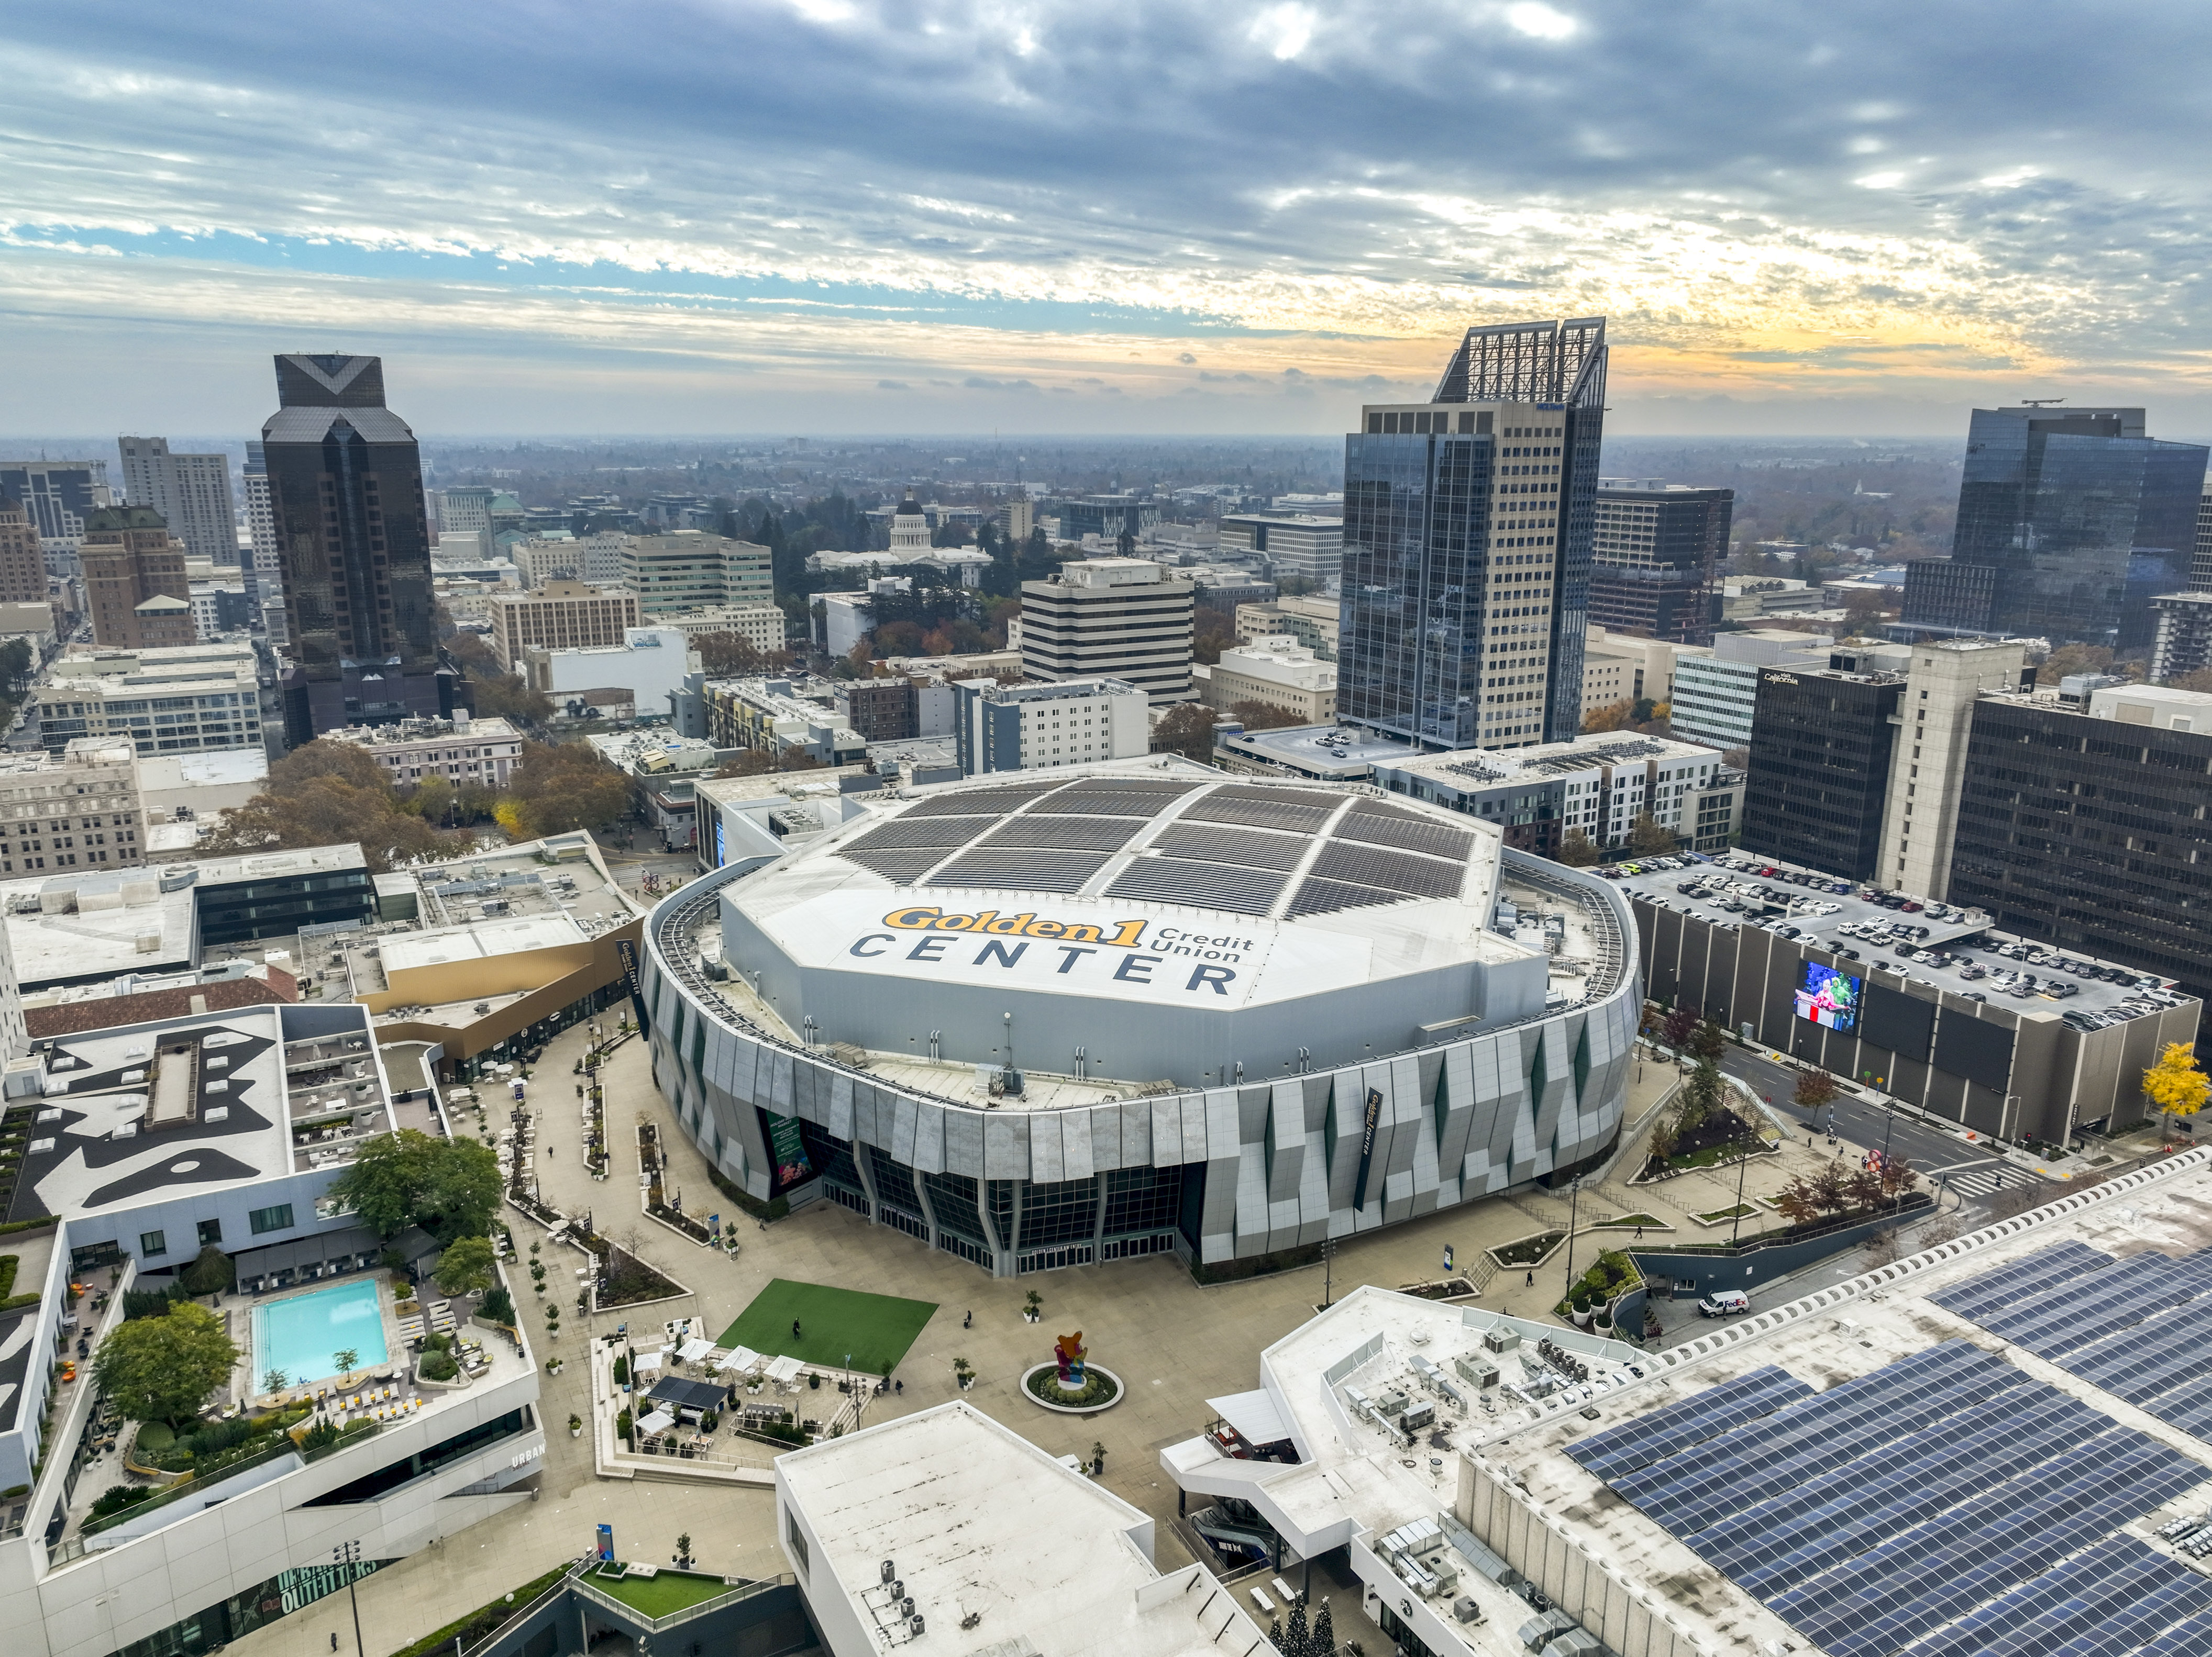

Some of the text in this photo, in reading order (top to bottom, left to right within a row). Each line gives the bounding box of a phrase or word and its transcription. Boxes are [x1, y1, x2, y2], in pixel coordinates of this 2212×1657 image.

[1764, 673, 1798, 685] California
[1158, 928, 1254, 951] Credit
[1150, 940, 1240, 963] Union
[849, 933, 1236, 995] CENTER
[629, 971, 640, 995] CENTER
[770, 1119, 785, 1127] HOLIDAY
[778, 1119, 792, 1128] MARKET
[1363, 1127, 1372, 1155] CENTER
[886, 1205, 896, 1213] GOLDEN
[898, 1210, 908, 1218] CENTER
[1725, 1299, 1746, 1307] FedEx
[512, 1443, 545, 1467] URBAN
